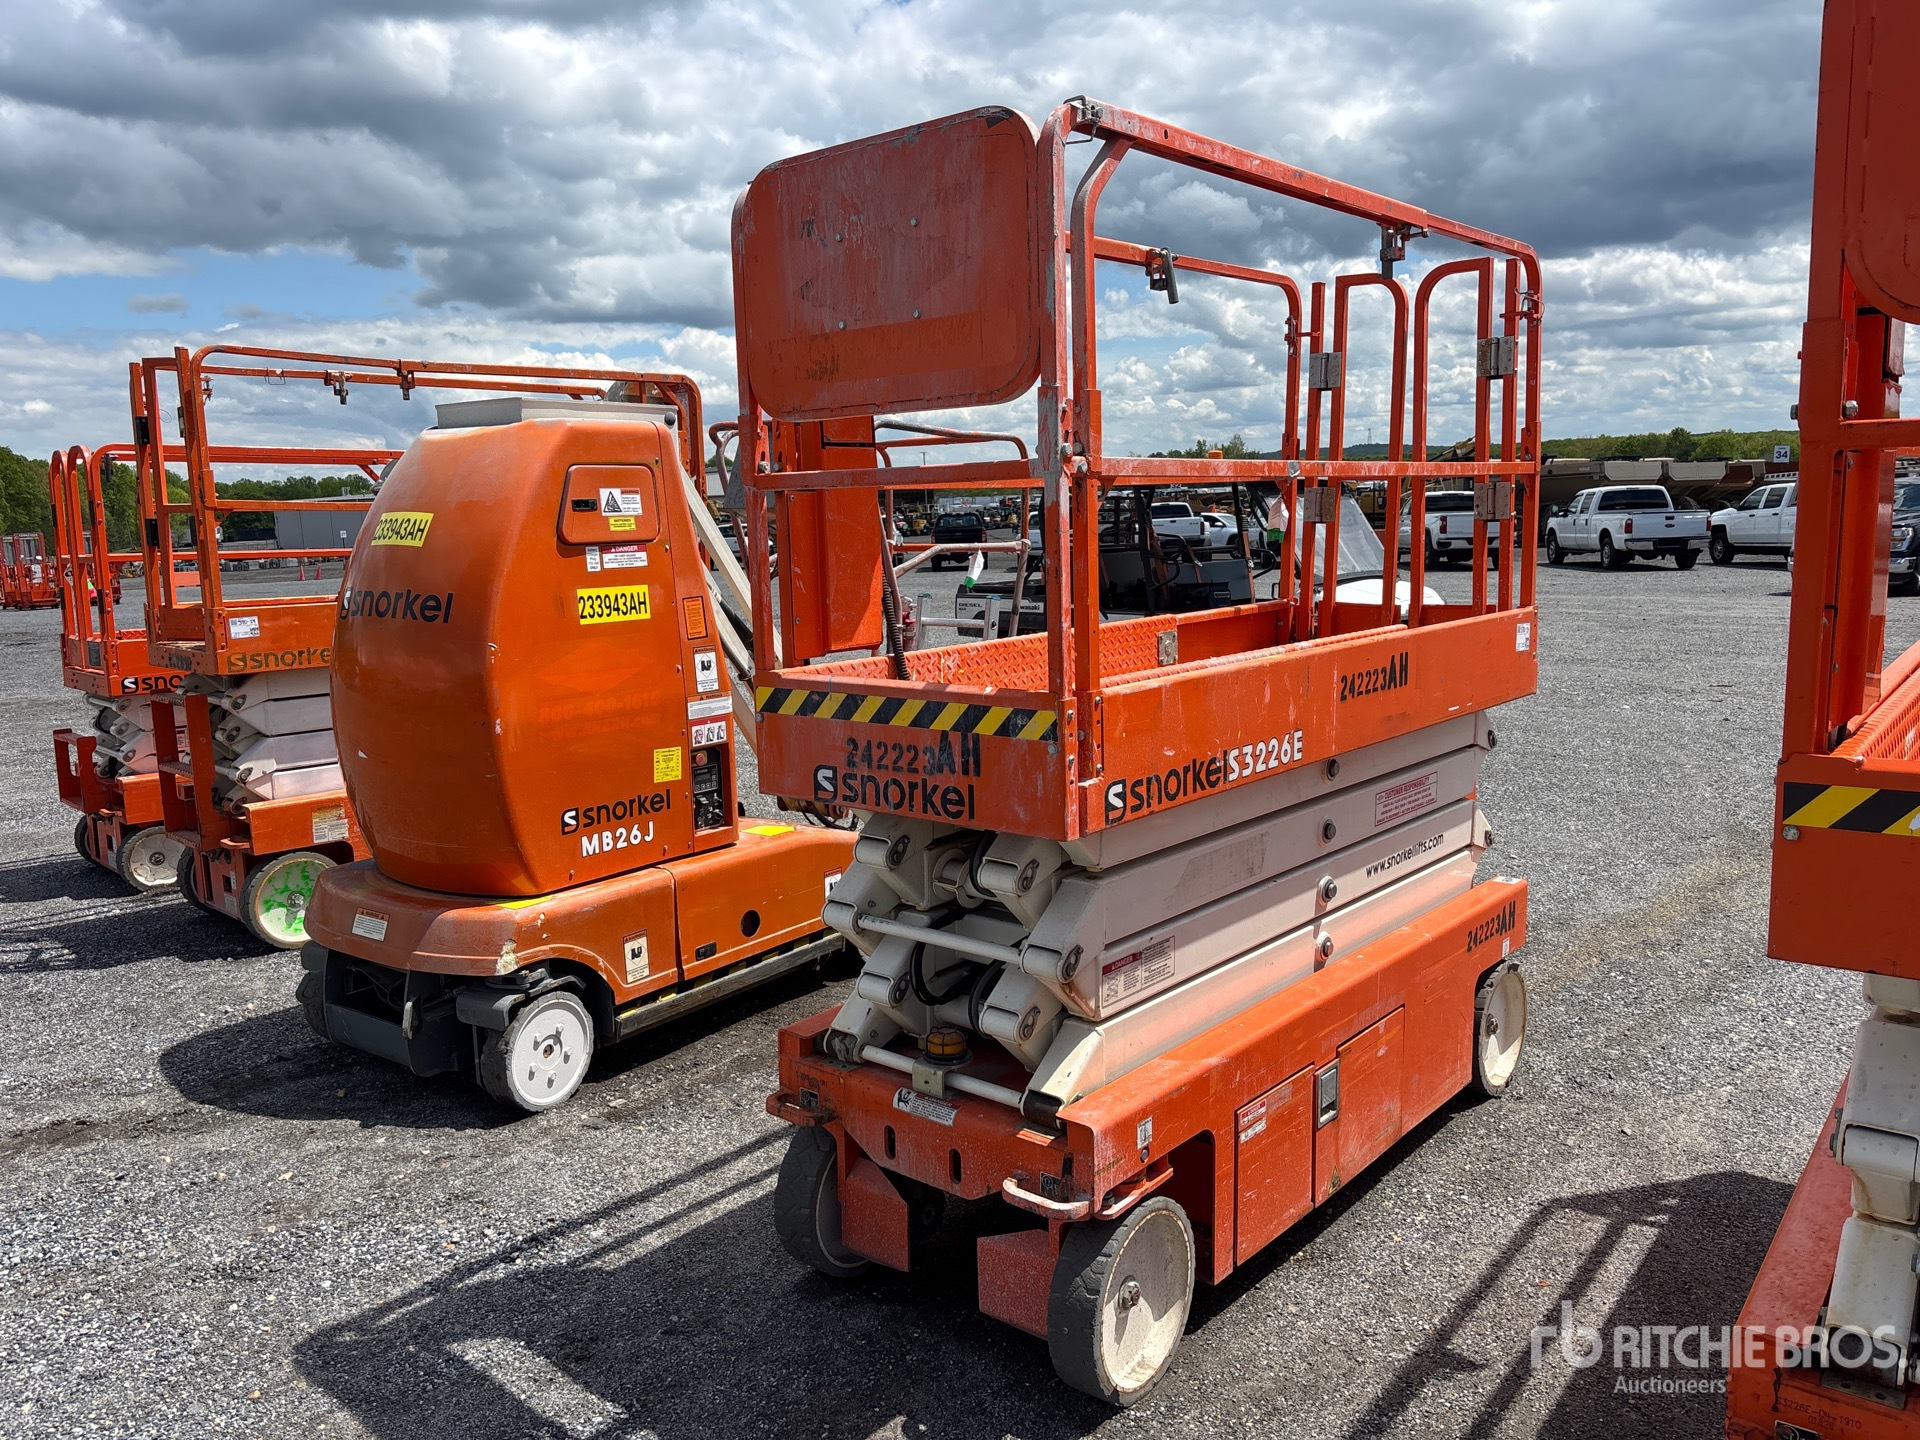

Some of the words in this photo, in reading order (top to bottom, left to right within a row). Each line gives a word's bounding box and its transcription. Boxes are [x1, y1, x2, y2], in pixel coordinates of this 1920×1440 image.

[1775, 450, 1788, 459] 34
[373, 517, 429, 542] 233943AH
[351, 588, 454, 623] snorkel
[578, 592, 648, 619] 233943AH
[250, 646, 332, 670] snorke
[1340, 651, 1408, 702] 242223AH
[846, 730, 981, 777] 242223AH
[1130, 750, 1228, 815] snorkel
[1228, 729, 1303, 782] S3226E
[582, 788, 671, 829] snorkel
[841, 771, 975, 821] snorkel
[581, 820, 654, 858] MB26J
[1365, 833, 1445, 878] www.snorkellifts.com
[1467, 900, 1516, 953] 242223AH
[1115, 955, 1133, 969] DANGER
